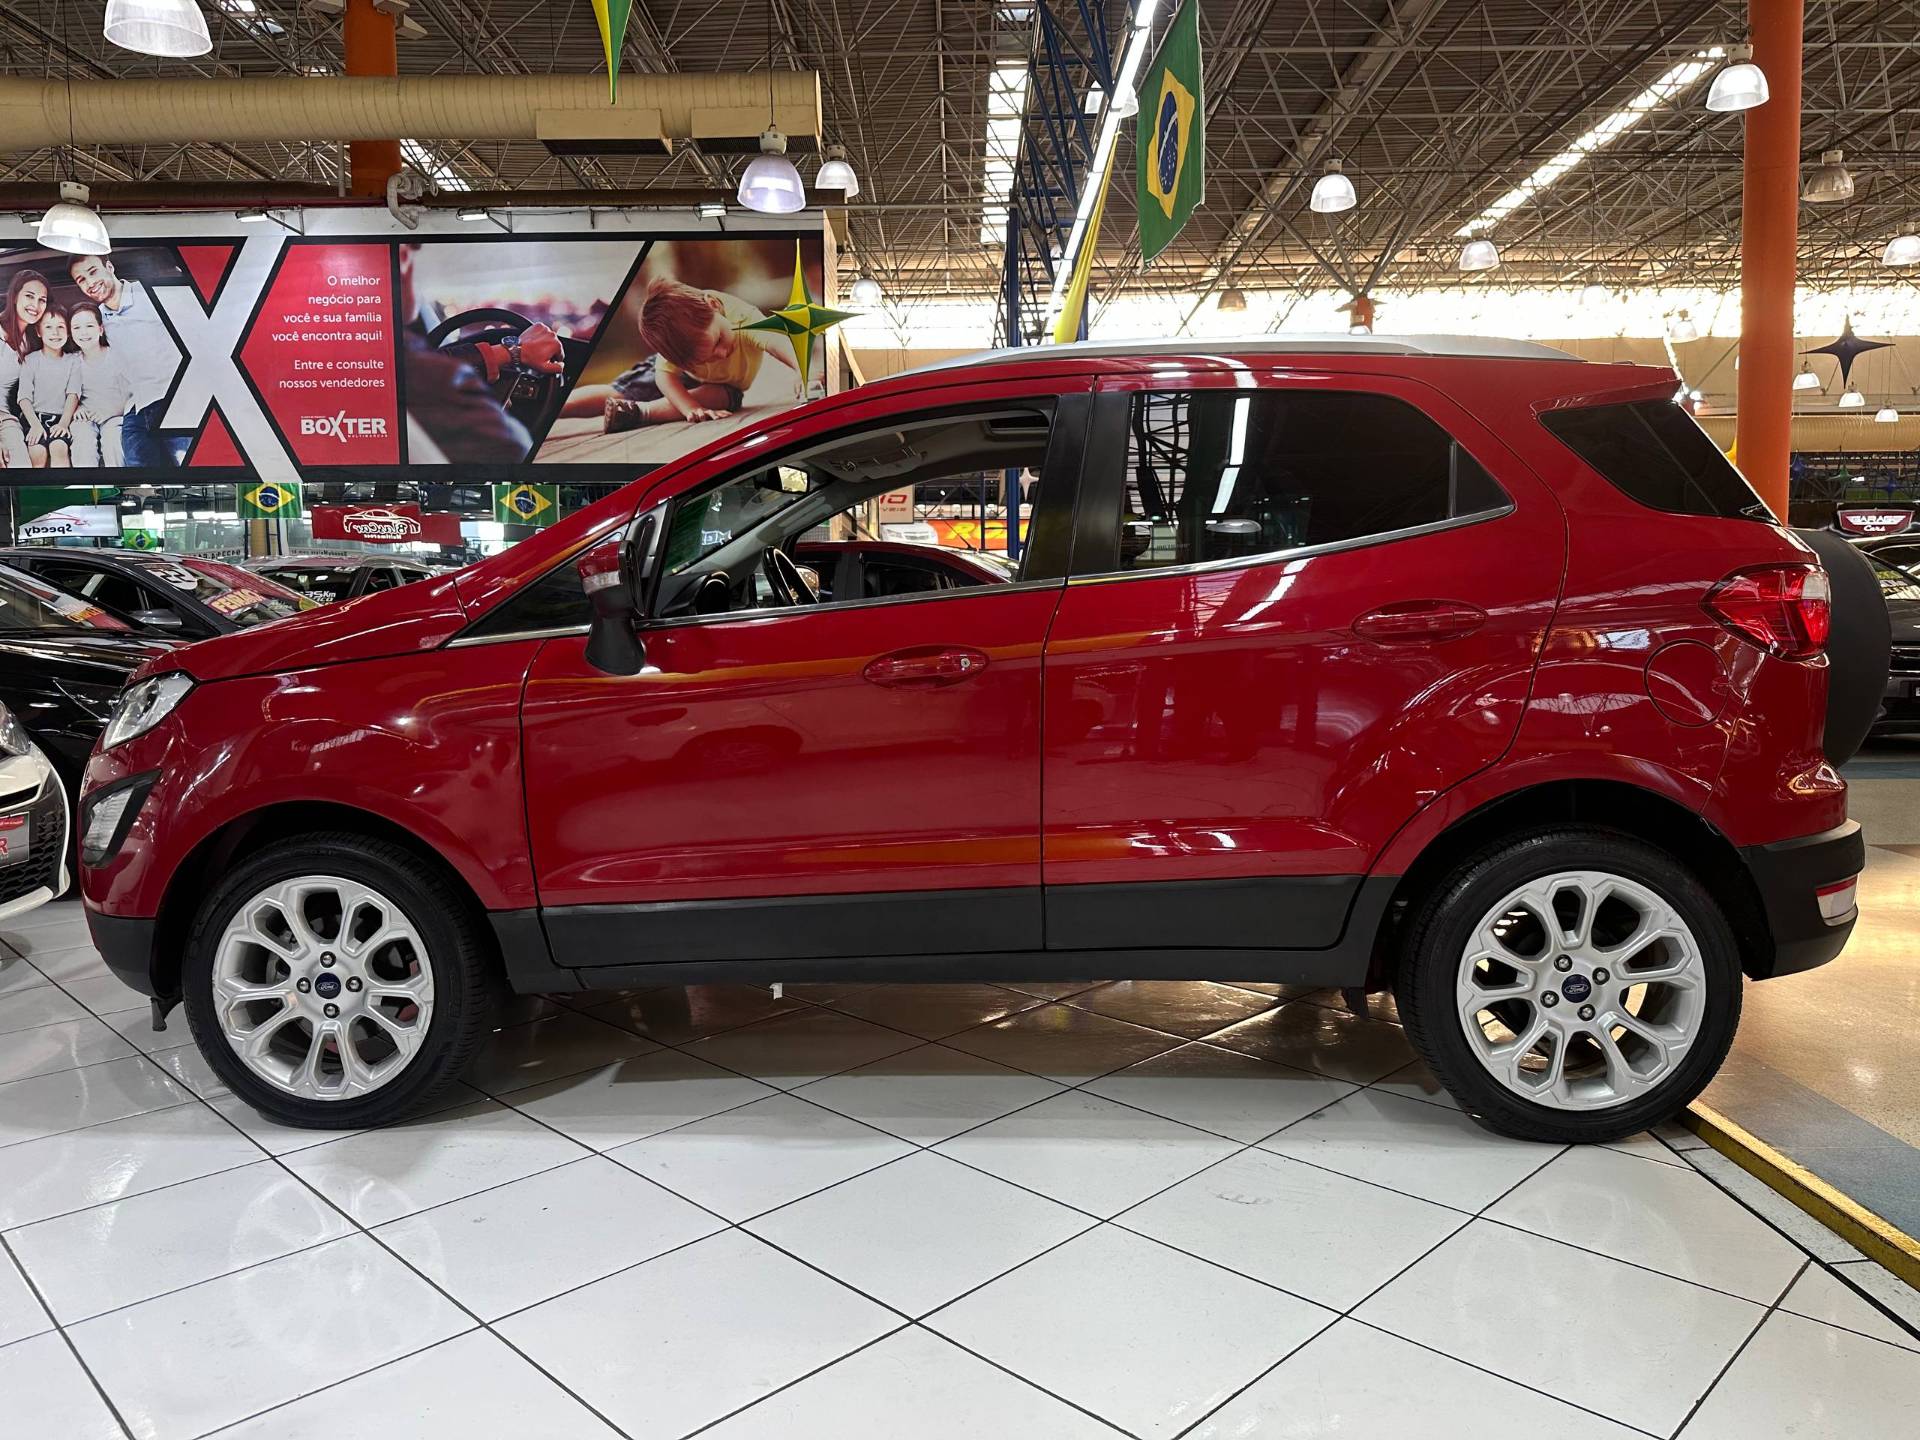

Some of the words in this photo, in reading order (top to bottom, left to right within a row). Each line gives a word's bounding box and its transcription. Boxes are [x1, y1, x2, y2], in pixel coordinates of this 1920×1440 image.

[328, 276, 337, 286] O
[341, 276, 380, 286] melhor
[308, 294, 353, 306] negócio
[357, 295, 381, 307] para
[284, 313, 310, 323] você
[314, 314, 320, 322] e
[323, 314, 342, 322] sua
[345, 312, 382, 322] família
[272, 332, 299, 341] você
[302, 332, 352, 341] encontra
[355, 332, 382, 342] aqui!
[295, 360, 323, 369] Entre
[337, 360, 384, 369] consulte
[280, 380, 317, 388] nossos
[320, 379, 384, 388] vendedores
[300, 410, 387, 443] BOXTER
